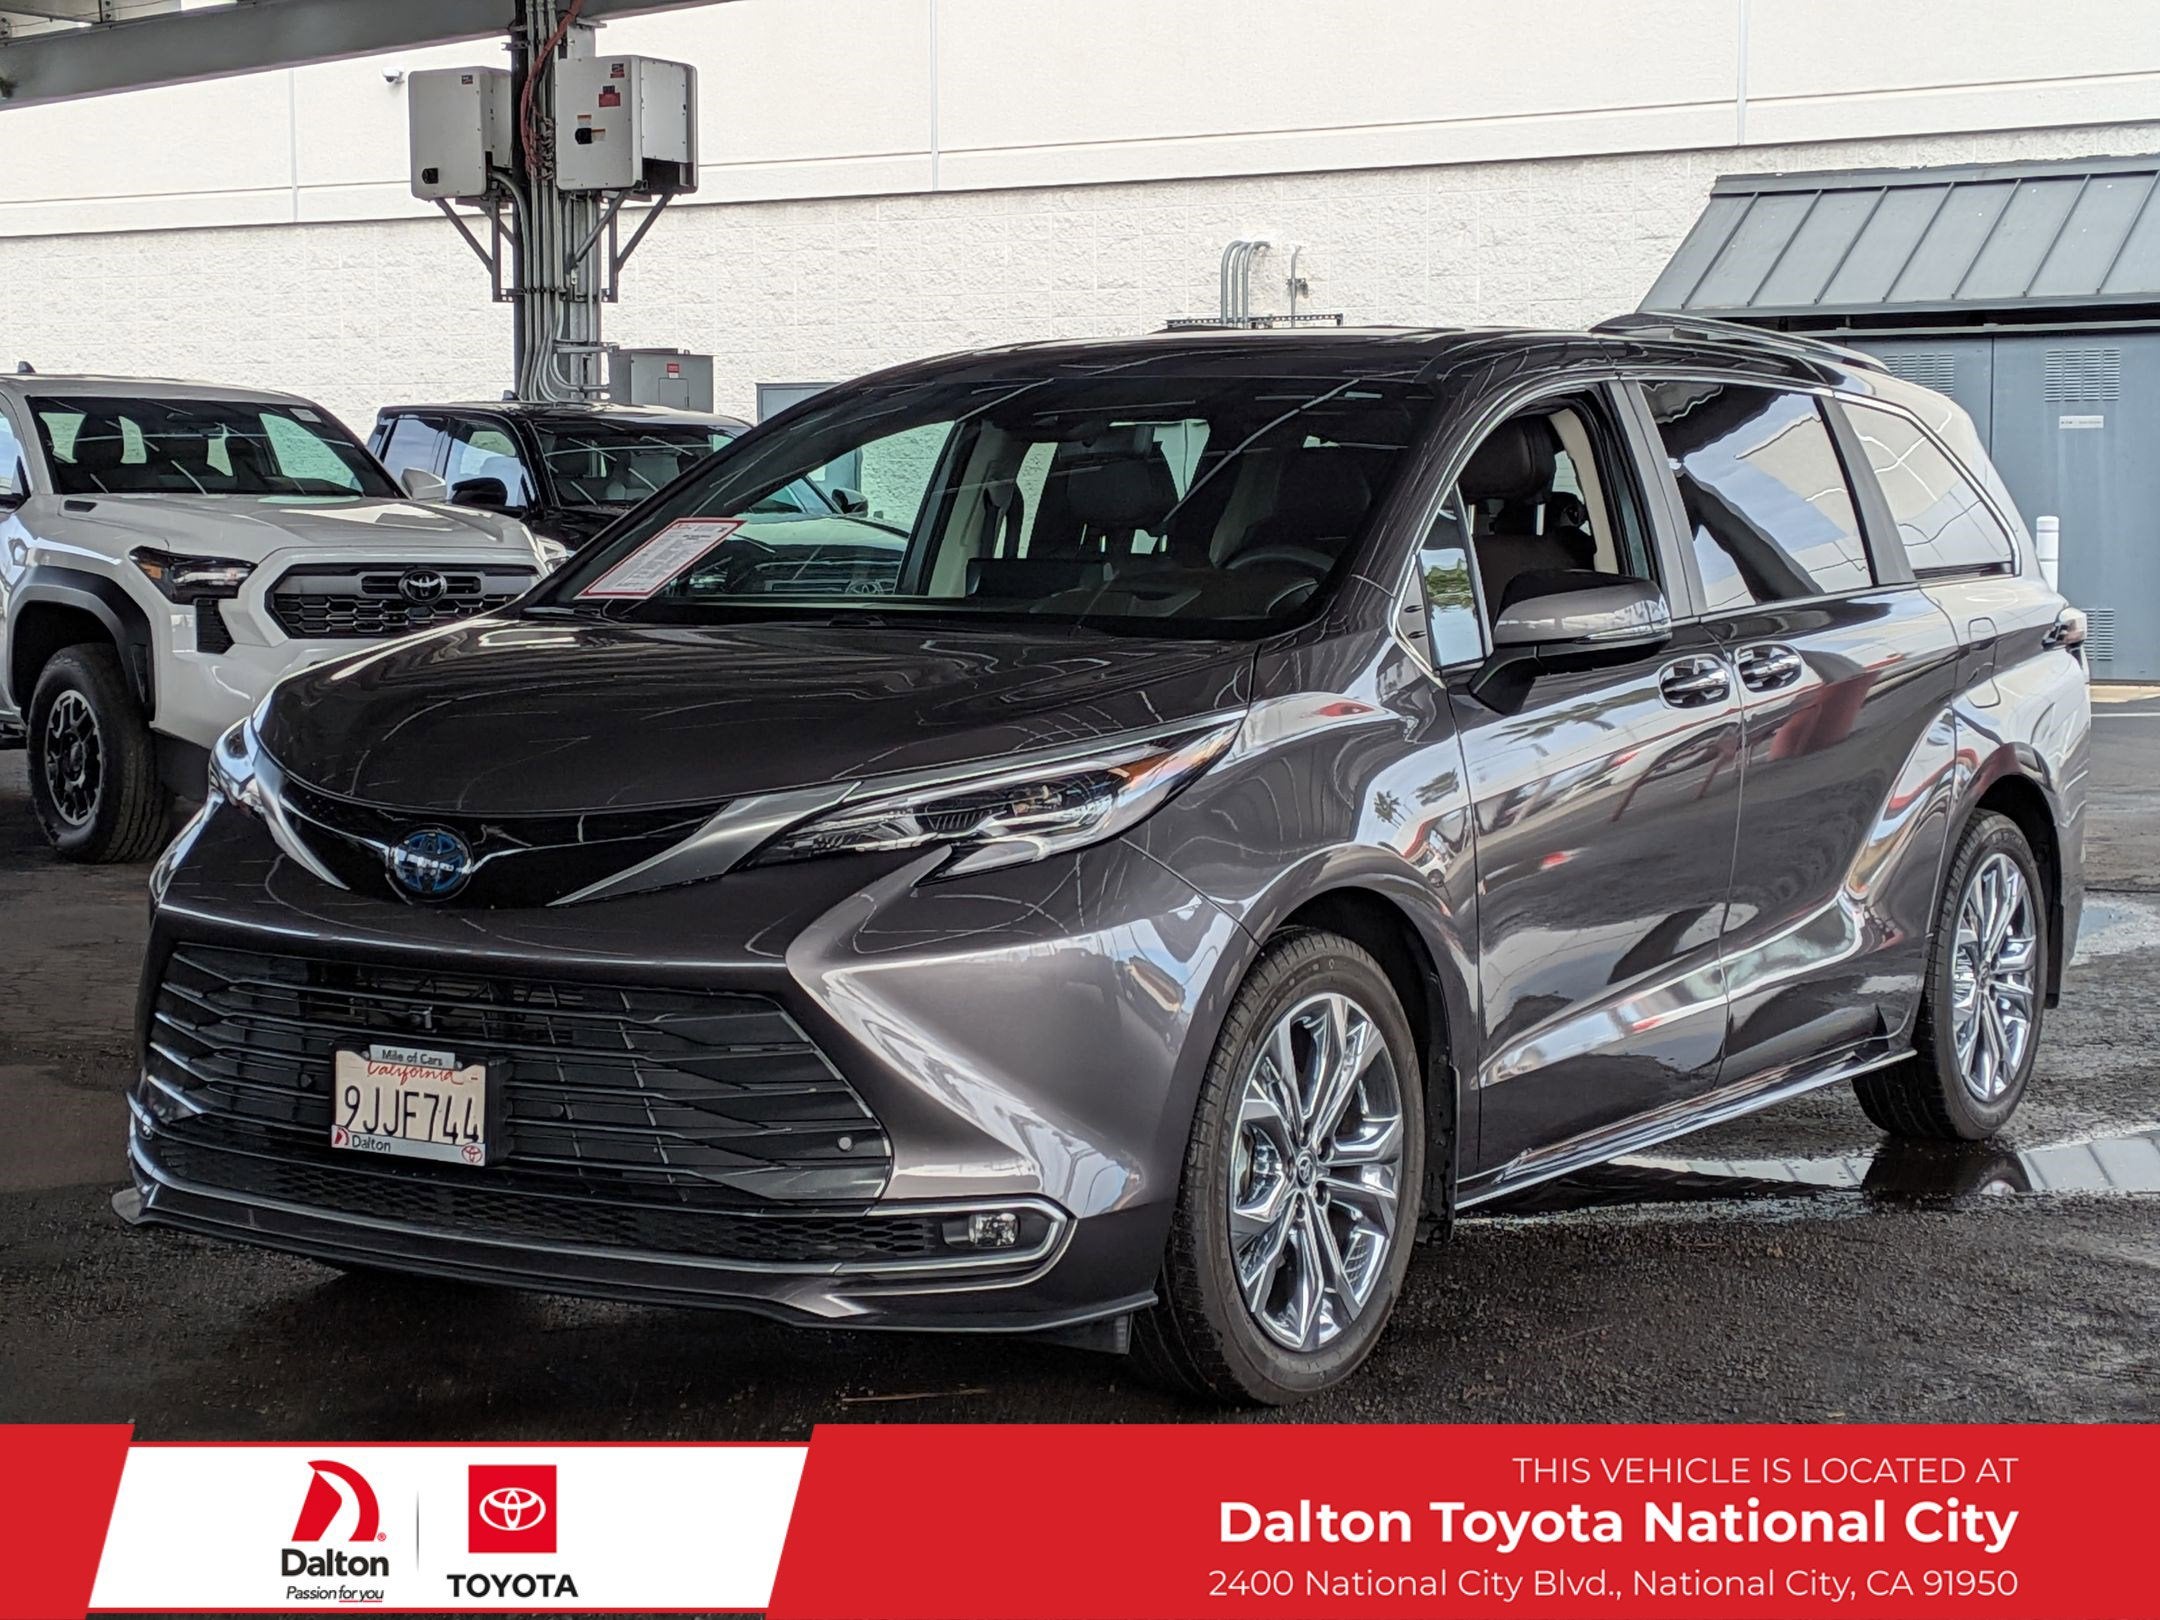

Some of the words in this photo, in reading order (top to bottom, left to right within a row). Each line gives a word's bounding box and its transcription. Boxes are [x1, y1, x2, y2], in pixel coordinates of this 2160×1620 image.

[382, 1049, 404, 1062] Mile
[407, 1052, 418, 1063] of
[420, 1053, 443, 1066] Cars
[344, 1085, 479, 1146] 9JJF744
[351, 1134, 391, 1152] Dalton
